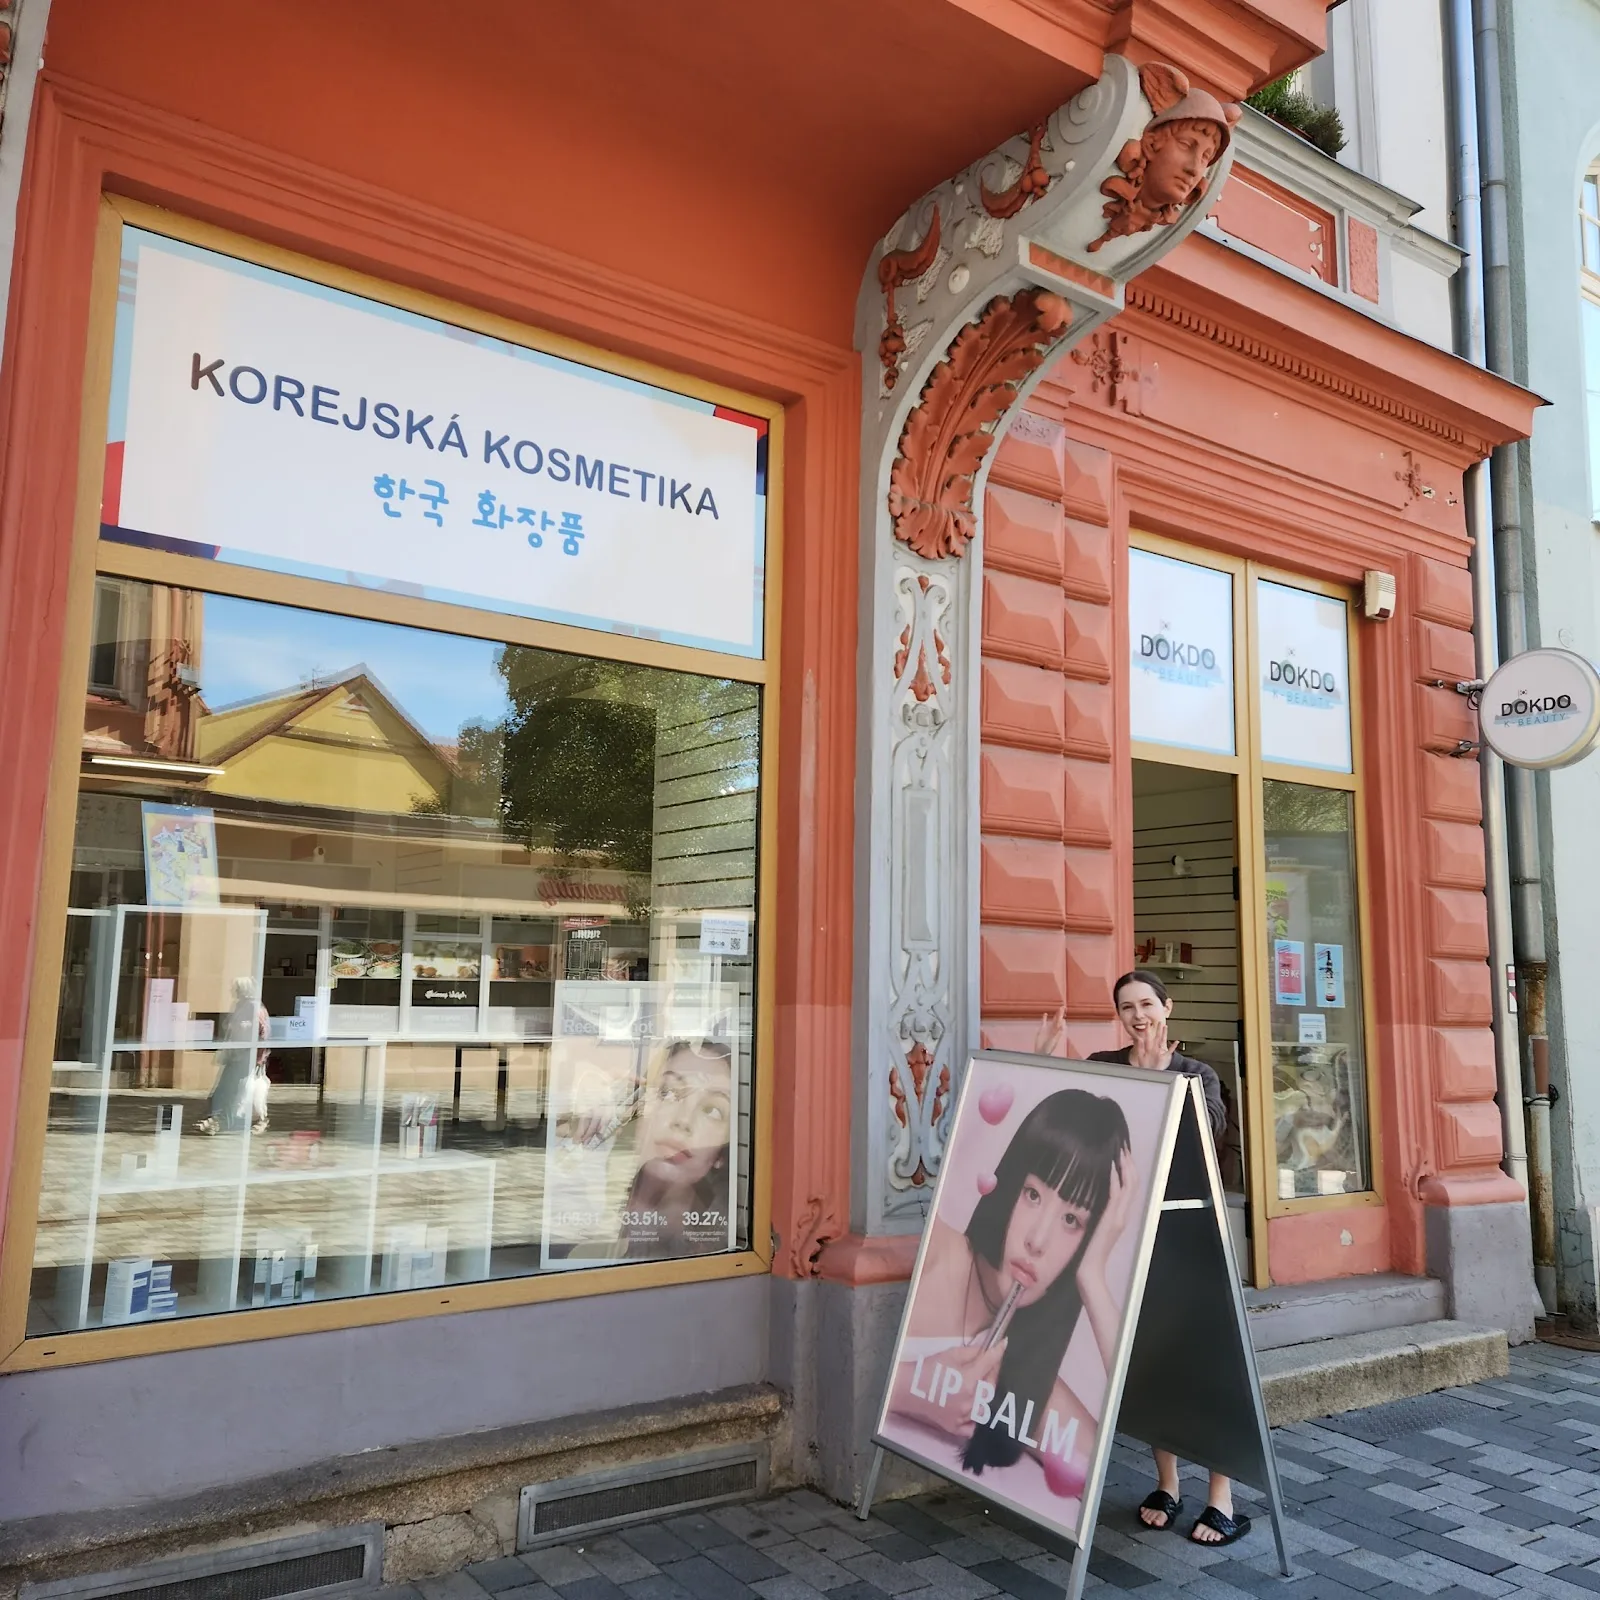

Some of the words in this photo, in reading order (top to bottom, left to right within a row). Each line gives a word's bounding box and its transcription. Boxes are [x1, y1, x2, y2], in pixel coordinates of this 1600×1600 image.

[191, 352, 469, 458] KOREJSKÁ
[484, 430, 719, 520] KOSMETIKA
[373, 473, 450, 528] 한국
[472, 489, 586, 557] 화장품
[1141, 634, 1216, 670] DOKDO
[1270, 660, 1336, 693] DOKDO
[1501, 694, 1572, 717] DOKDO
[1503, 712, 1567, 728] K-BEAUTY
[289, 1019, 307, 1028] Neck
[621, 1210, 668, 1226] 33.51%
[682, 1210, 728, 1226] 39.27%
[910, 1354, 964, 1408] LIP
[970, 1378, 1080, 1463] BALM
